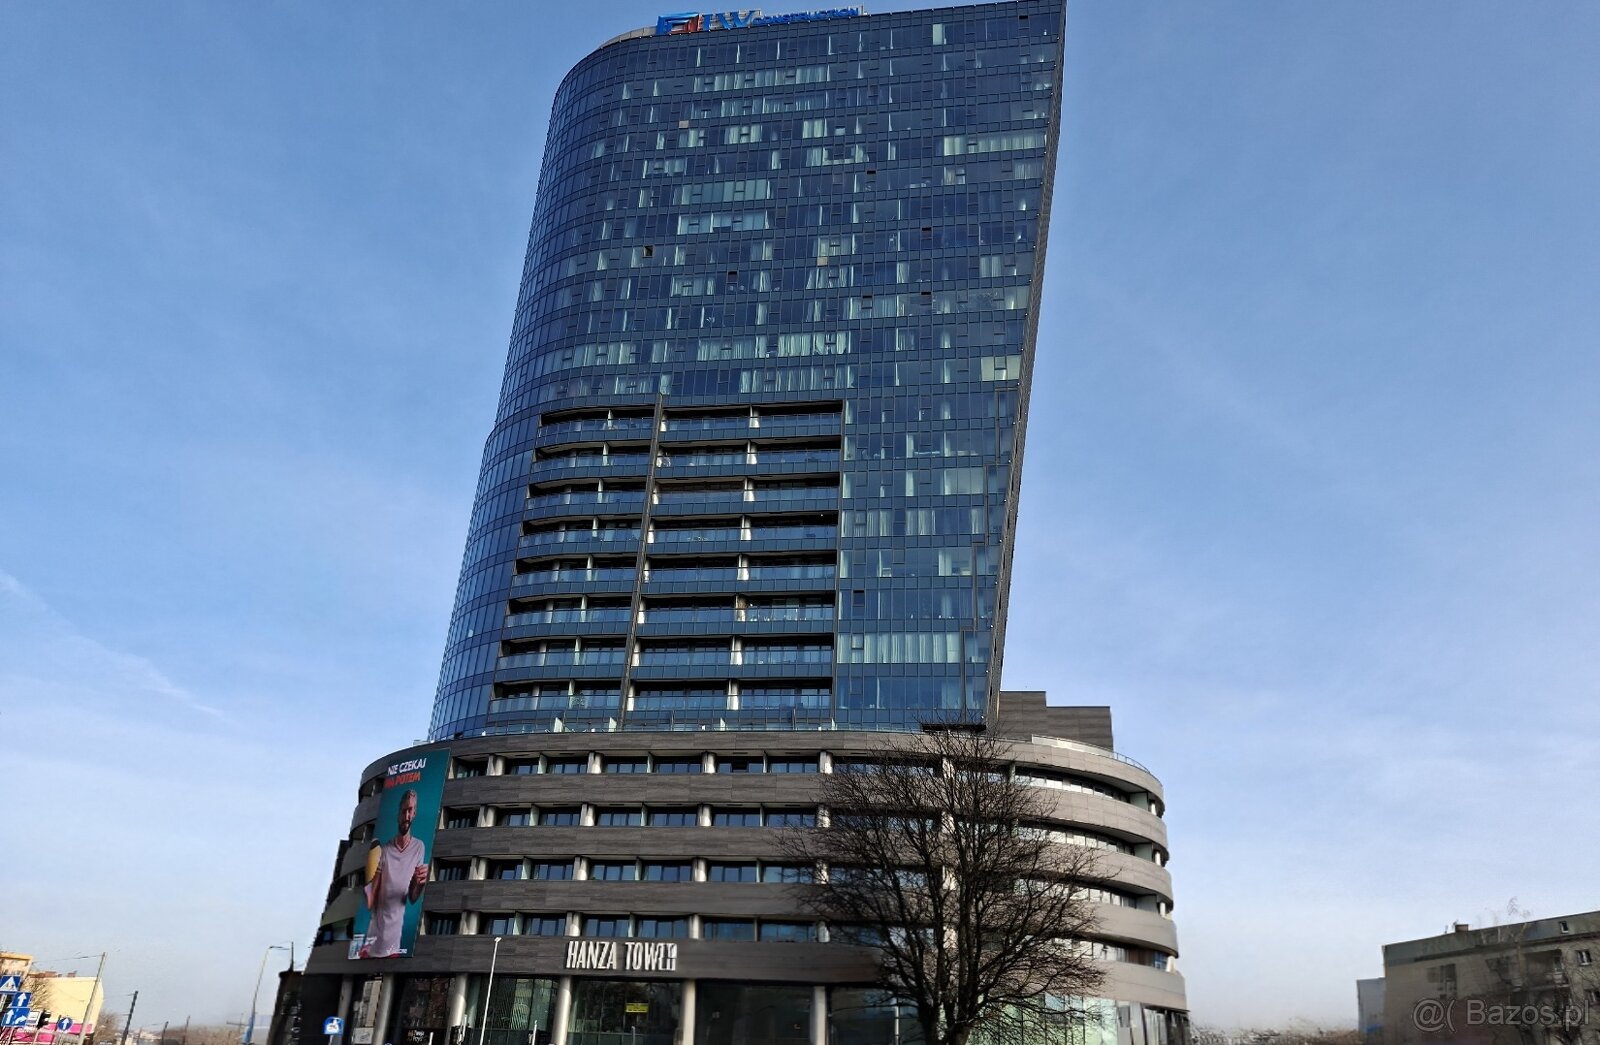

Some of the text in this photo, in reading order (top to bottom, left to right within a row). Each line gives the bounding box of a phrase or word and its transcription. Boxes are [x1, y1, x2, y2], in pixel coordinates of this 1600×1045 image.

[388, 758, 427, 776] NIE CZEKAJ
[395, 771, 421, 785] POTEM
[566, 940, 678, 971] HANZA TOWER
